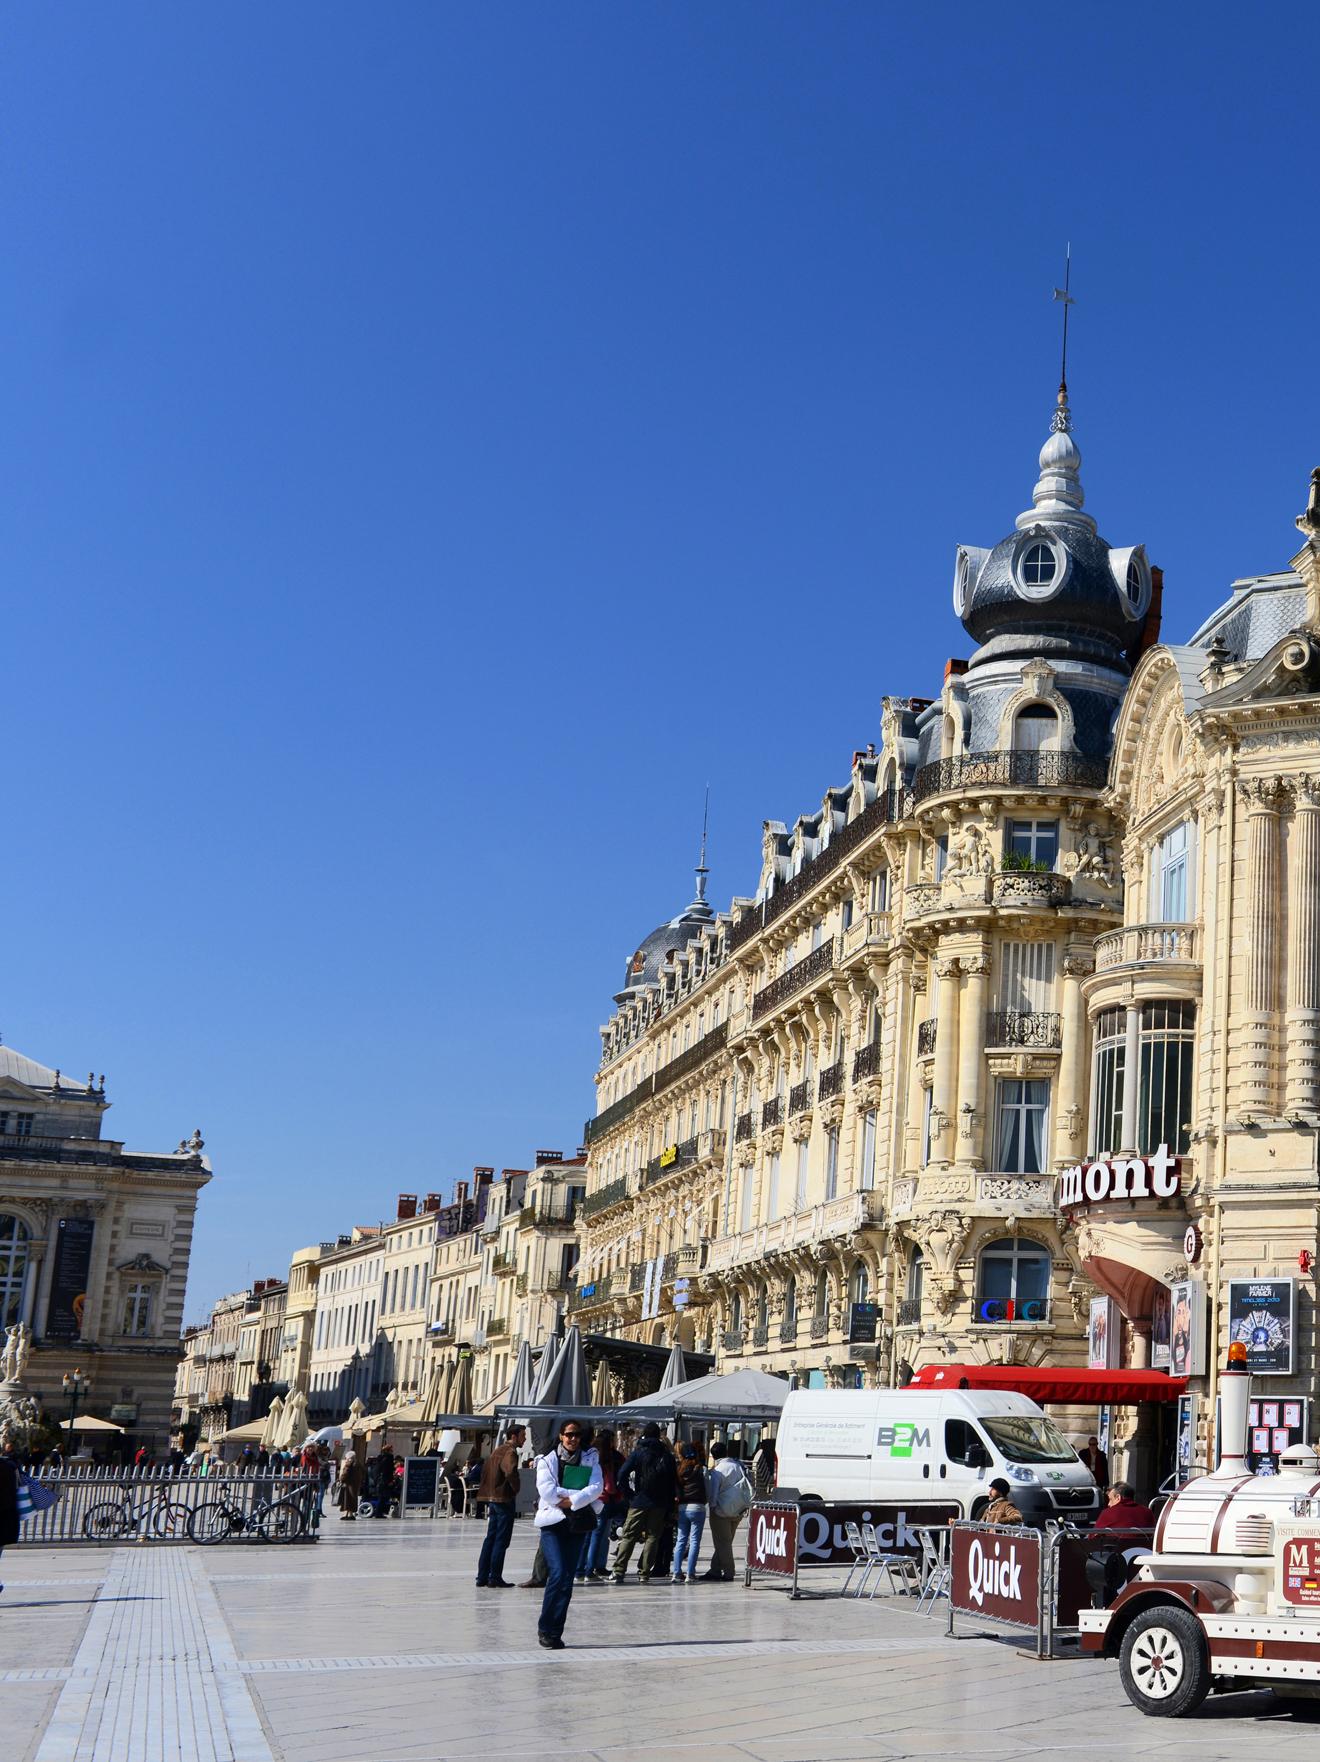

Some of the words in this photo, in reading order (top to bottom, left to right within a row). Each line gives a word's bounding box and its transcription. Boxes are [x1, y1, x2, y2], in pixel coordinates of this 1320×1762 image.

[1059, 1143, 1178, 1206] mont
[981, 1300, 1041, 1322] CIC
[877, 1426, 931, 1448] B2M
[756, 1514, 787, 1565] Quick
[799, 1511, 921, 1559] Quck
[1276, 1528, 1295, 1536] VISITE
[968, 1539, 1022, 1607] Quick
[1288, 1544, 1310, 1567] M
